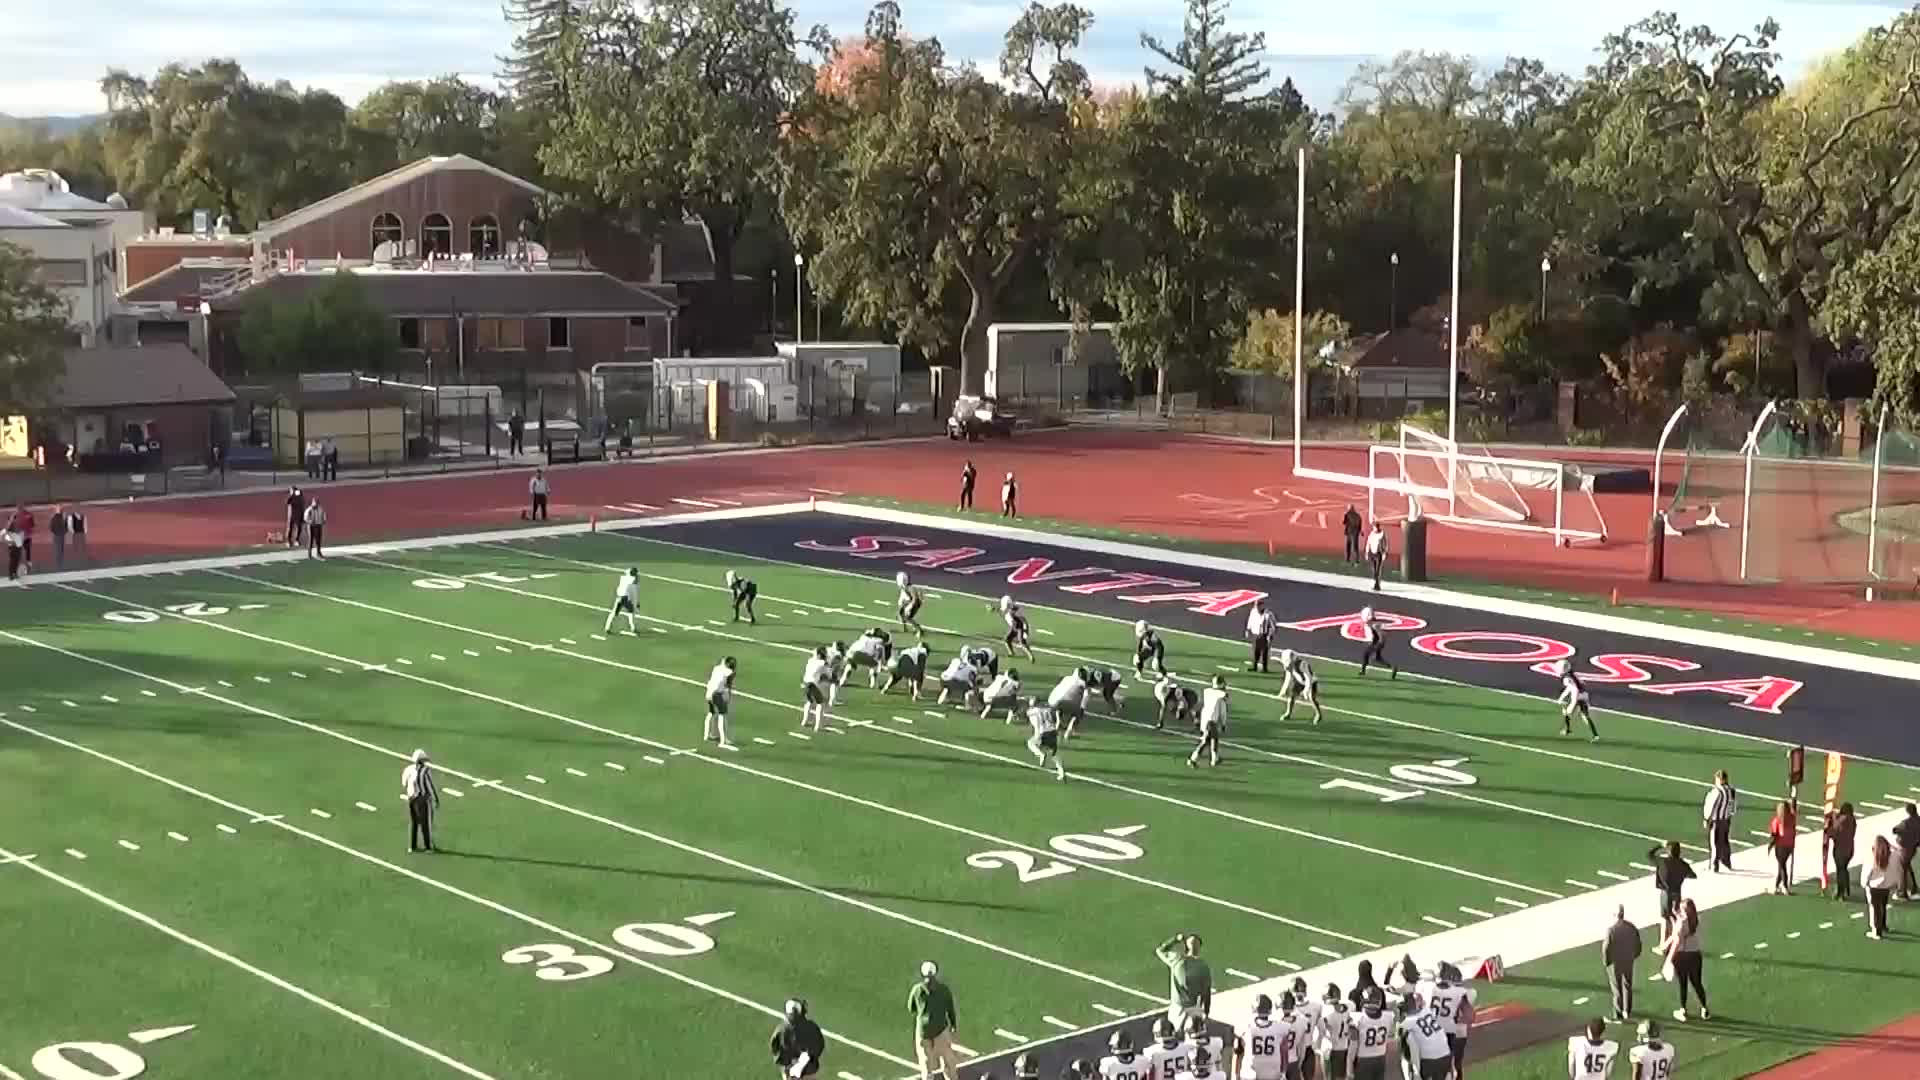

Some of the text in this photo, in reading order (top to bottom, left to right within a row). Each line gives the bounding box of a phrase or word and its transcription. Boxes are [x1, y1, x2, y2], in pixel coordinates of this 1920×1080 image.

[795, 536, 1804, 715] SANTA ROSA
[1319, 764, 1477, 802] 10
[965, 834, 1144, 883] 20
[501, 922, 716, 981] 30
[1251, 1035, 1276, 1056] 66
[1364, 1025, 1388, 1047] 83
[1583, 1053, 1607, 1073] 45
[1652, 1058, 1669, 1080] 19
